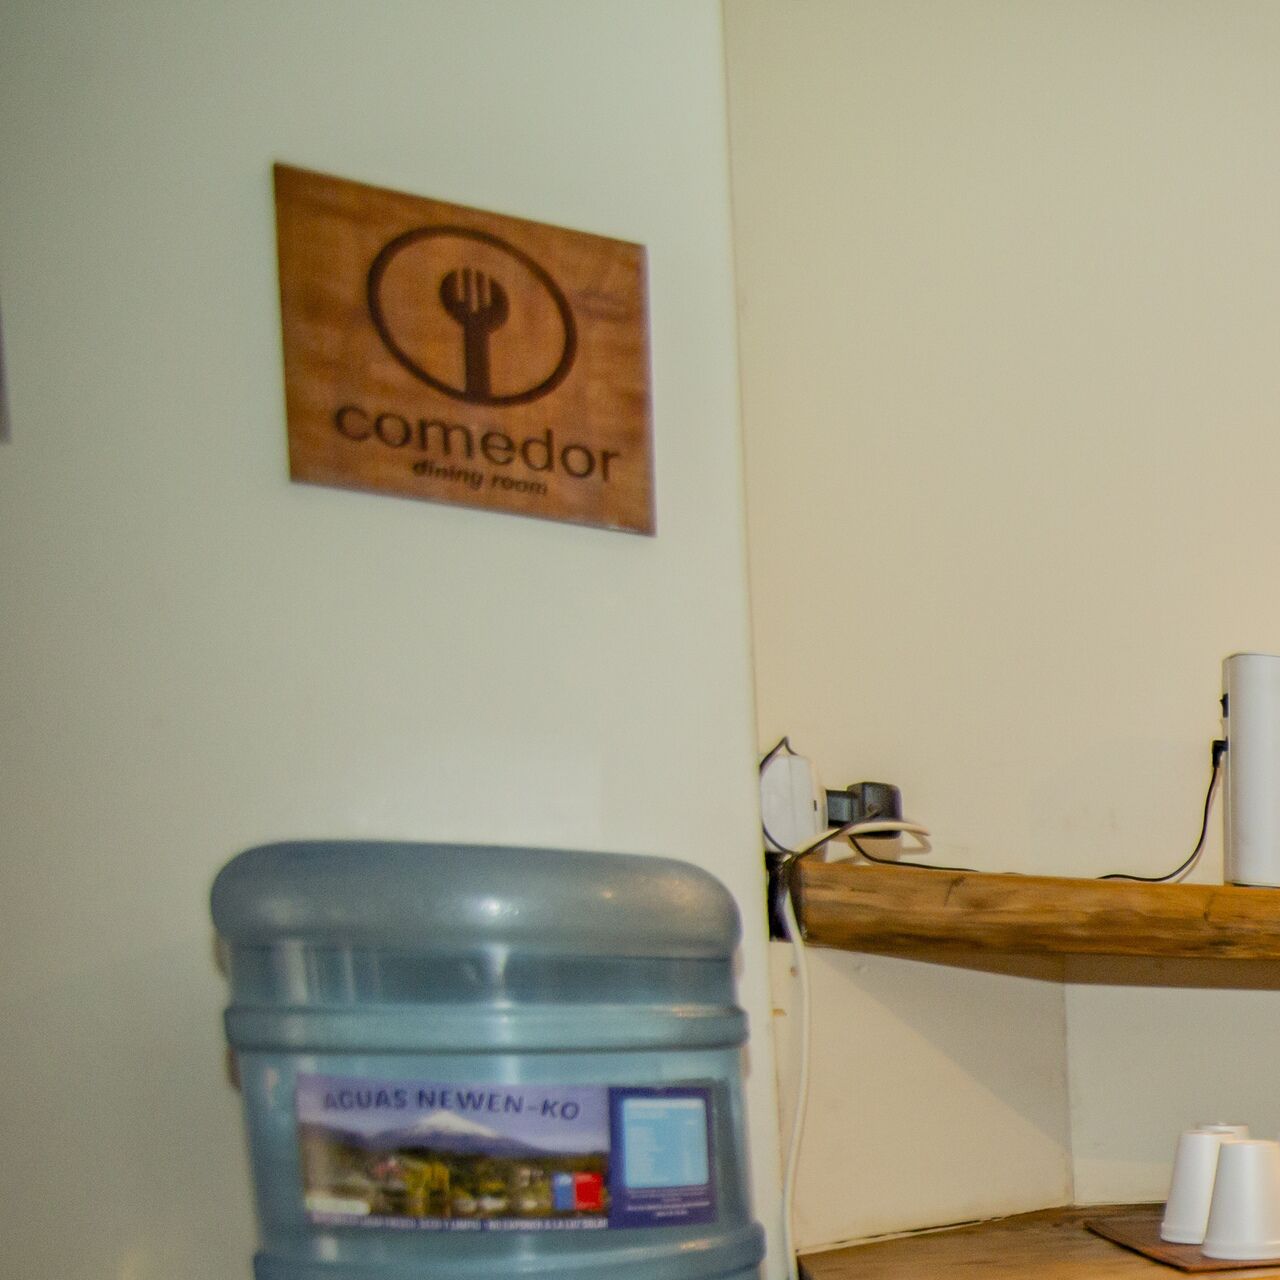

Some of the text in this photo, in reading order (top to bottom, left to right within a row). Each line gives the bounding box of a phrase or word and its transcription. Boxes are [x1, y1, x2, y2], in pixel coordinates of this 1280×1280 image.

[333, 404, 620, 482] comedor
[412, 459, 548, 496] dining room
[323, 1088, 408, 1111] AGUAS
